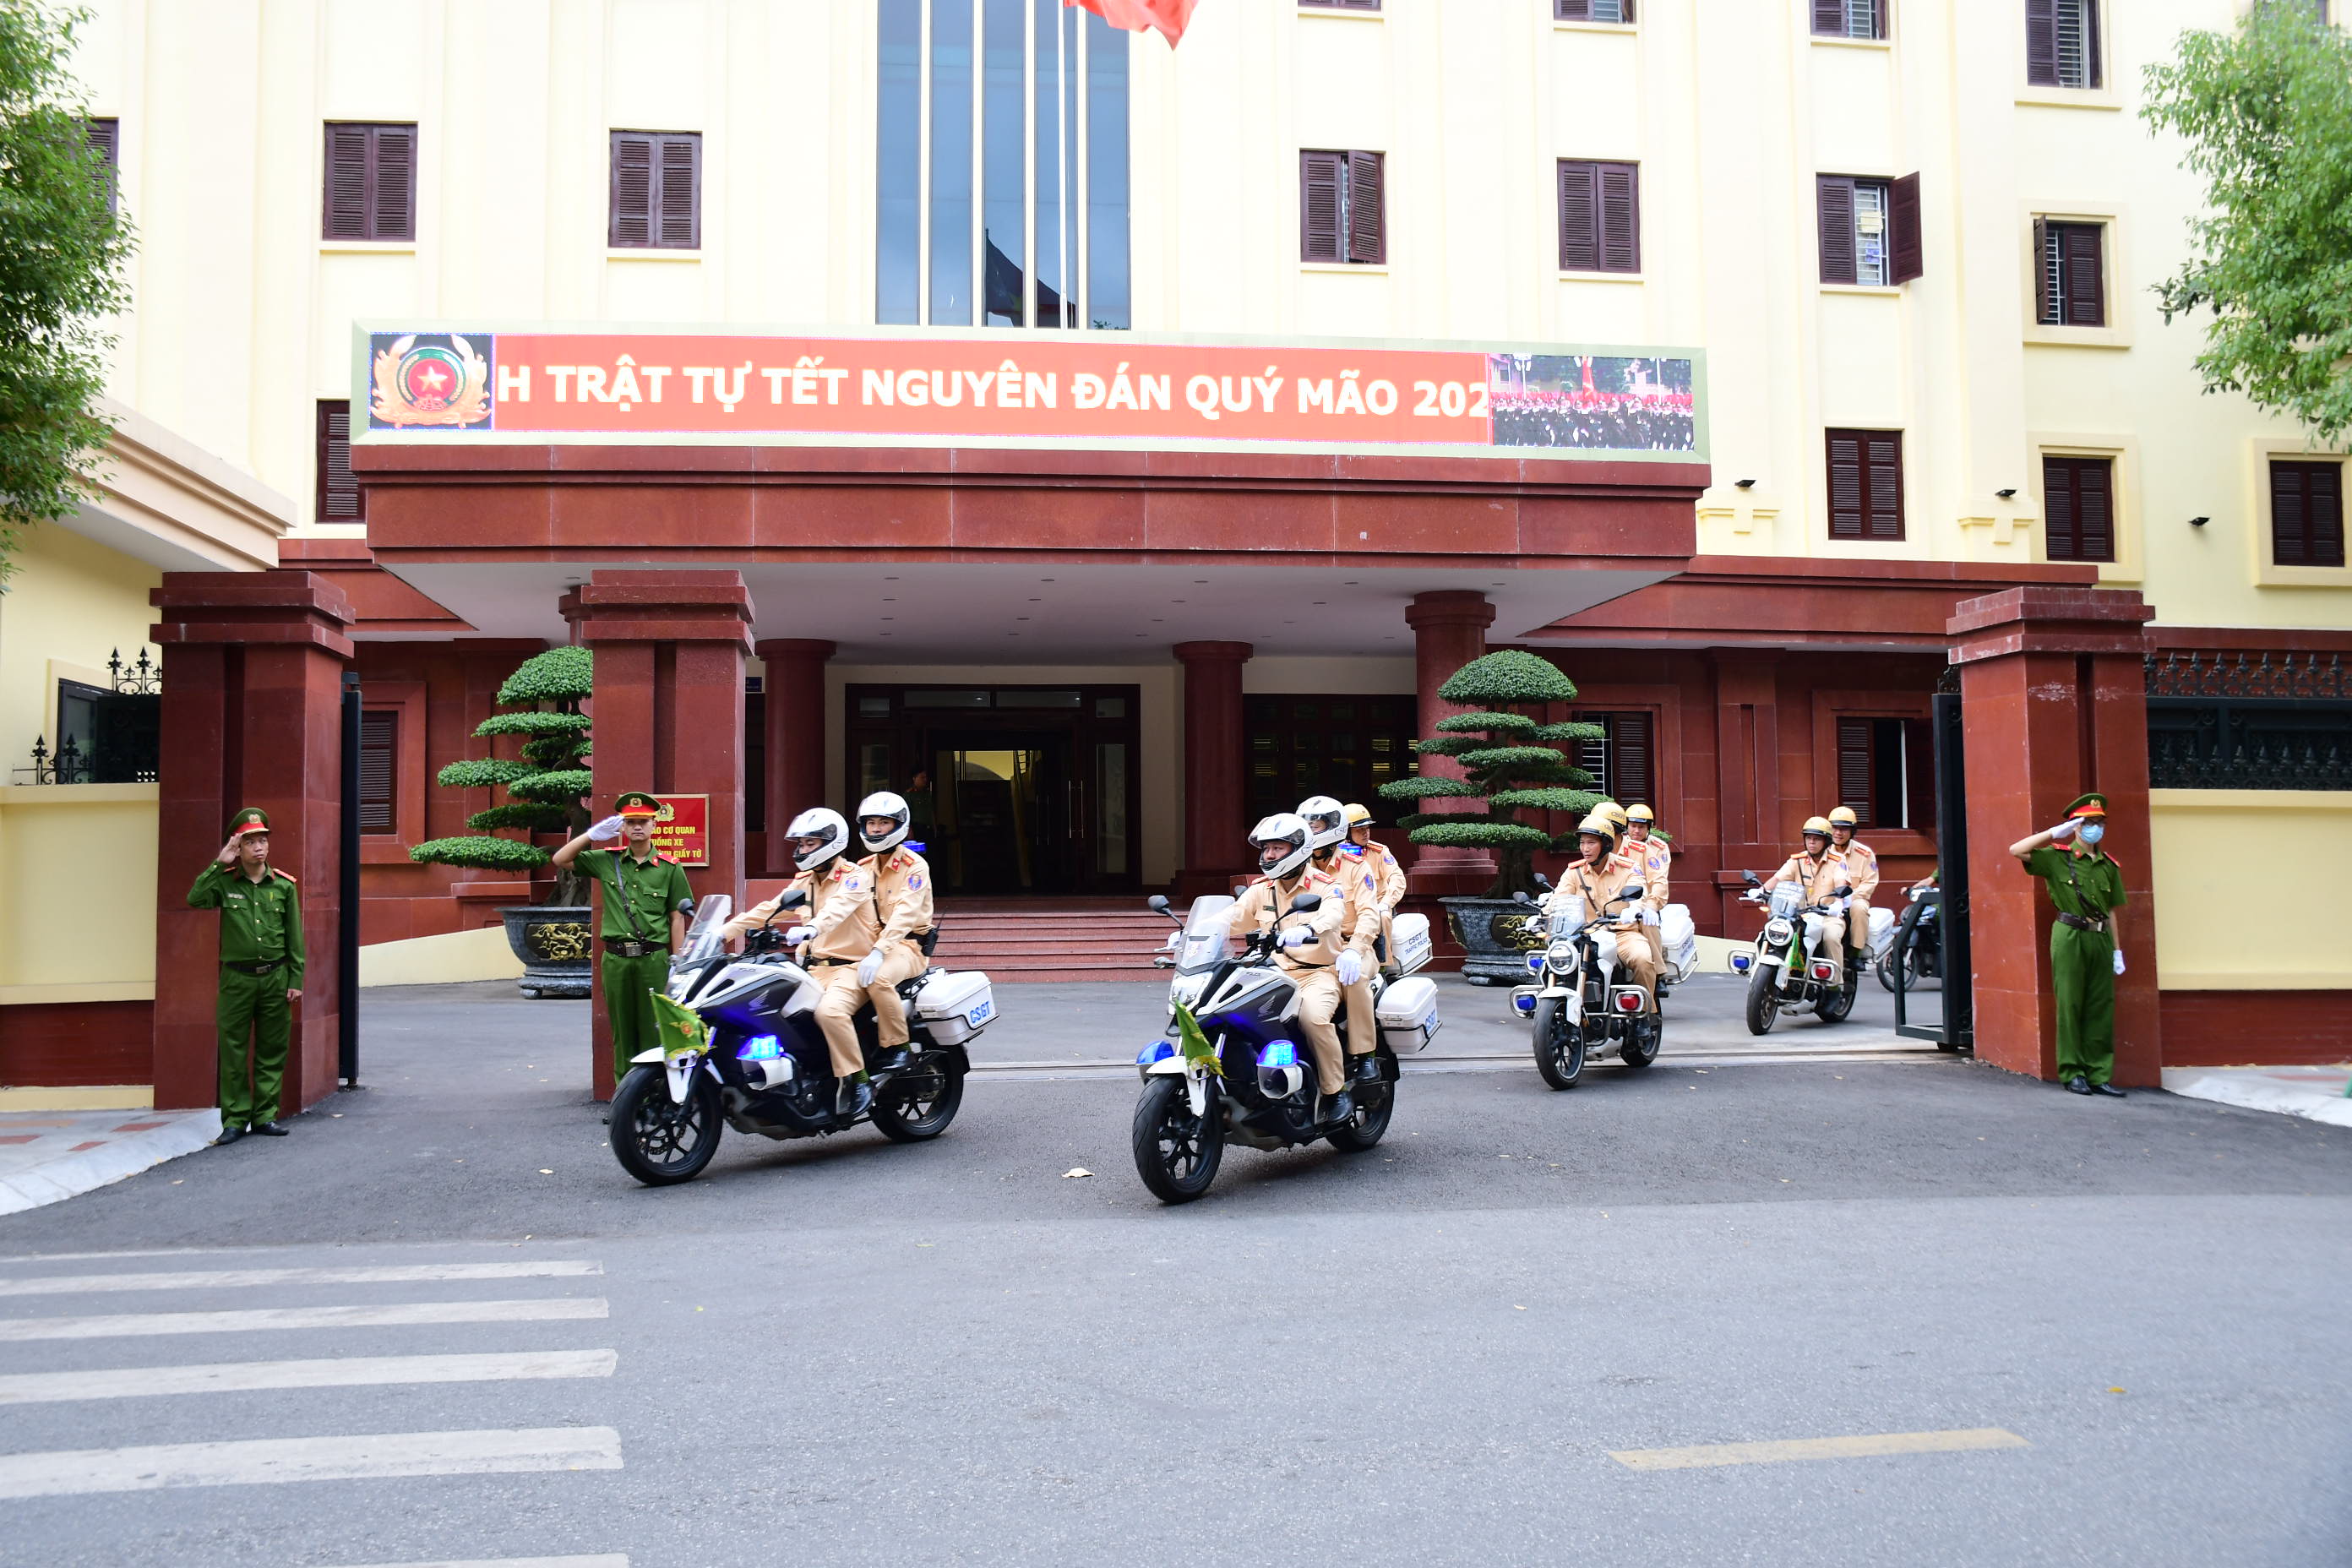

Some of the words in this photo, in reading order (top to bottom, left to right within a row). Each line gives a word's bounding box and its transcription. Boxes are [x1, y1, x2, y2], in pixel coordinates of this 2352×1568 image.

[546, 354, 672, 412] TRẬT
[682, 361, 753, 413] TỰ
[760, 356, 849, 406] TẾT
[862, 360, 1057, 409] NGUYÊN
[1070, 362, 1171, 411] ĐÁN
[1185, 366, 1284, 421] QUÝ
[1297, 370, 1398, 416] MÃO
[1413, 380, 1489, 417] 202
[675, 826, 695, 836] QUAN
[1408, 932, 1422, 945] CSGT
[970, 1001, 989, 1023] CSGT
